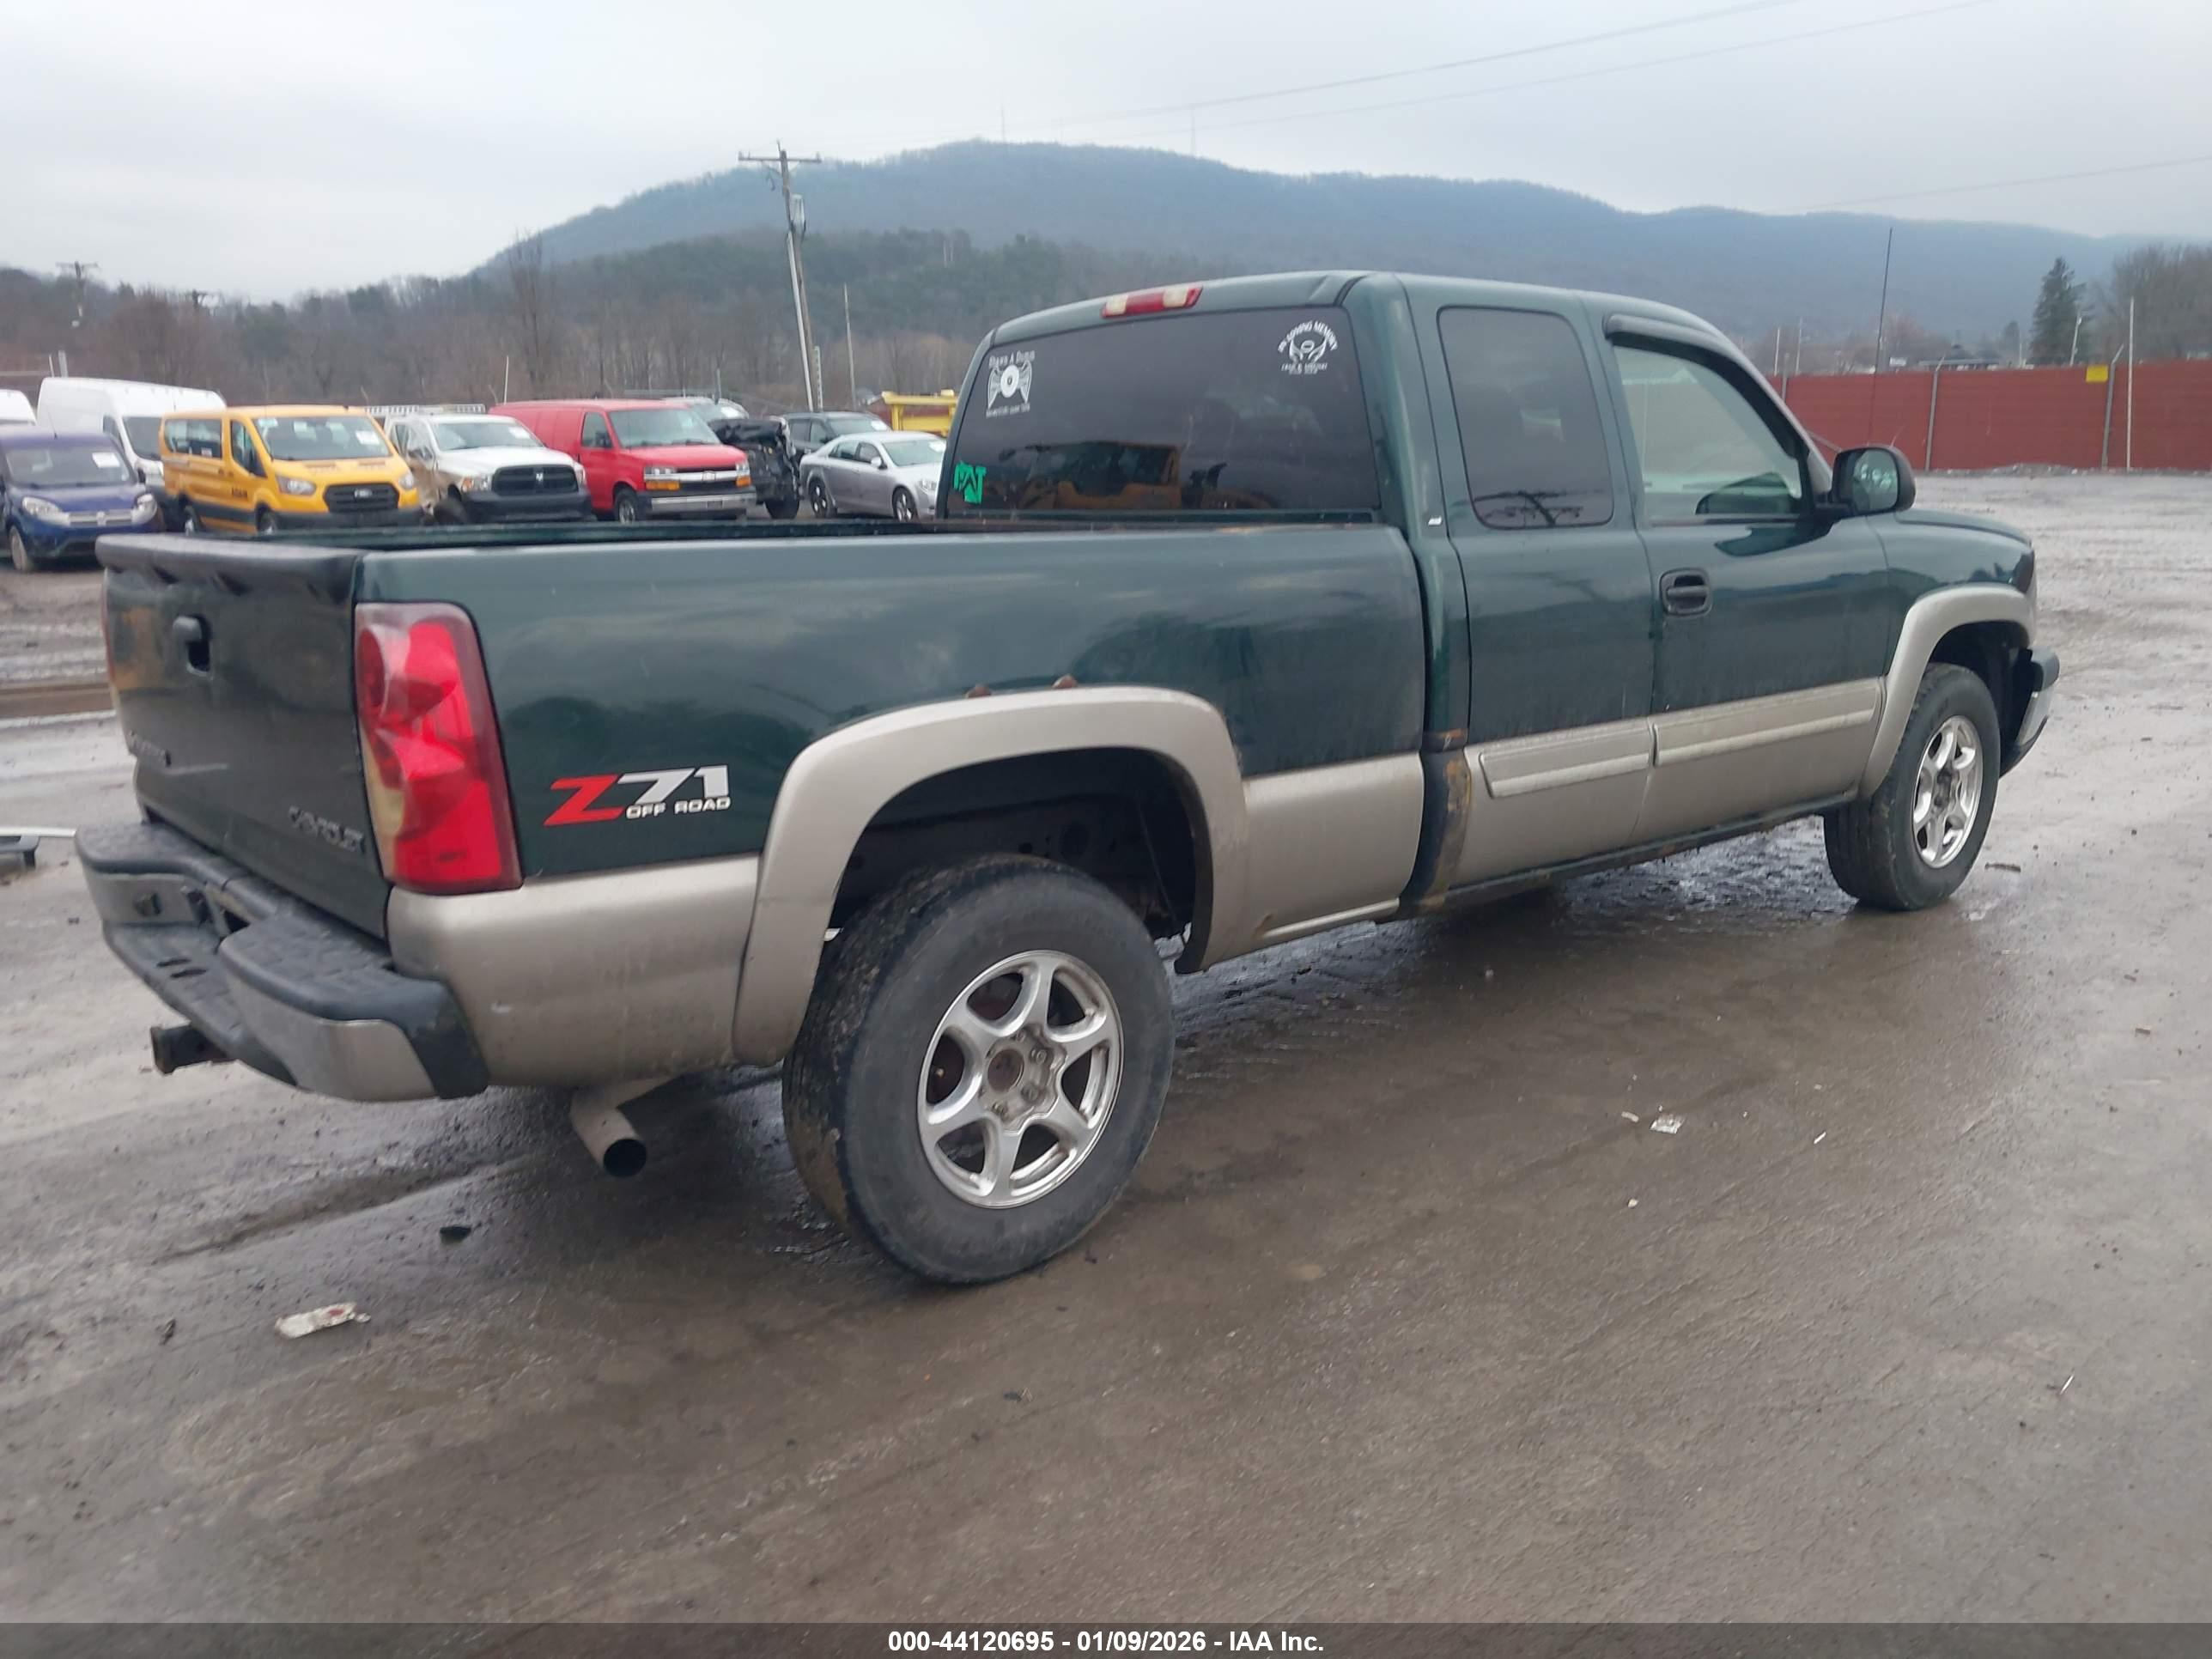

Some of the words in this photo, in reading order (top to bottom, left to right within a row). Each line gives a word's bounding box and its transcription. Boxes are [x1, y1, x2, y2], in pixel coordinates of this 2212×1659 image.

[544, 764, 729, 827] Z71
[625, 801, 666, 820] OFF
[674, 796, 732, 815] ROAD
